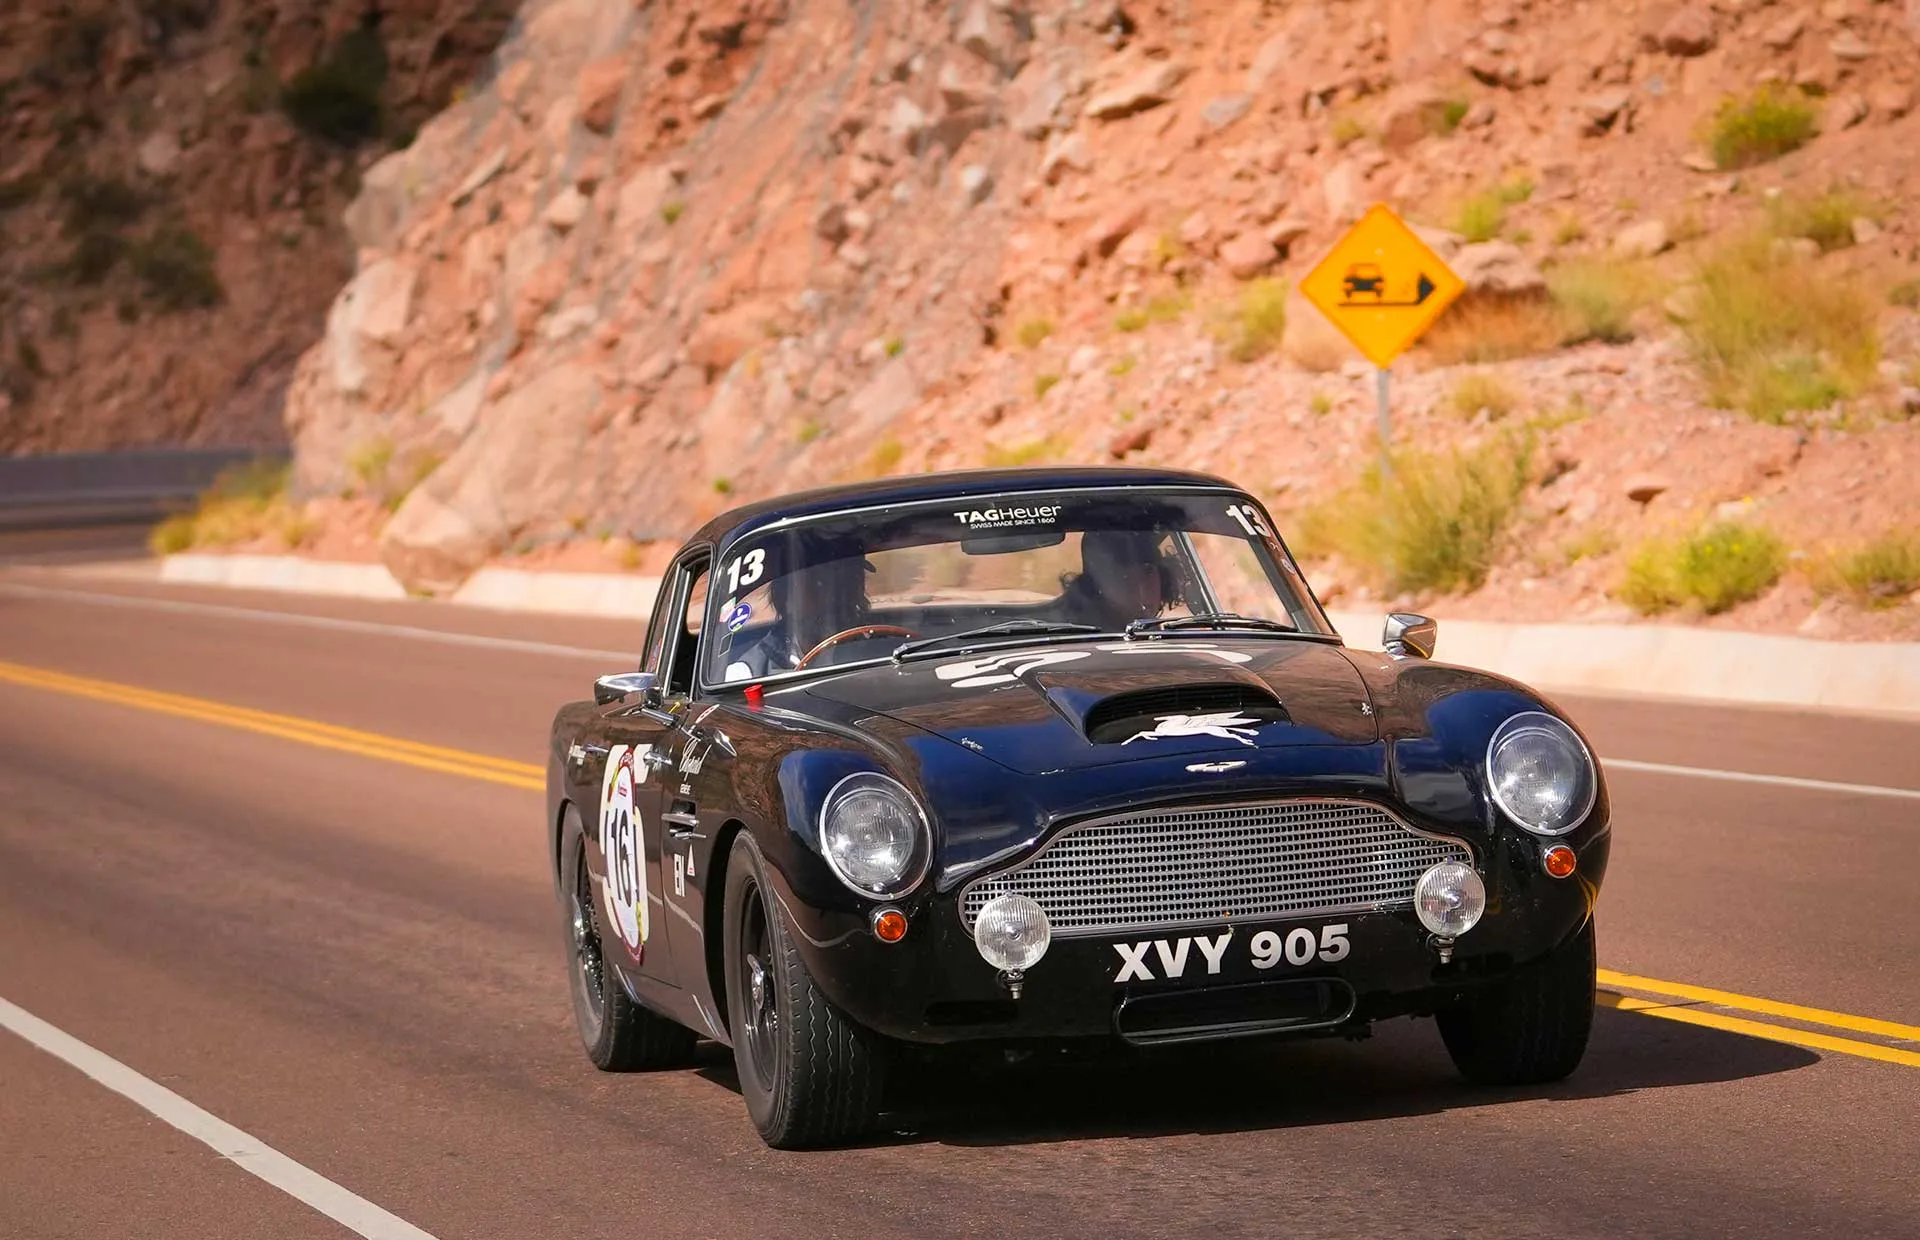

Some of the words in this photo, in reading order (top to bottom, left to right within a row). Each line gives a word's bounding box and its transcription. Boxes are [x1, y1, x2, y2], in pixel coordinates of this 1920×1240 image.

[970, 521, 993, 530] SWISS
[993, 519, 1014, 528] MADE
[1014, 518, 1036, 526] SINCE
[1037, 516, 1056, 524] 1860
[1225, 504, 1271, 538] 13
[727, 548, 766, 594] 13
[611, 808, 632, 908] 16
[1112, 933, 1234, 984] XVY
[1250, 923, 1351, 970] 905
